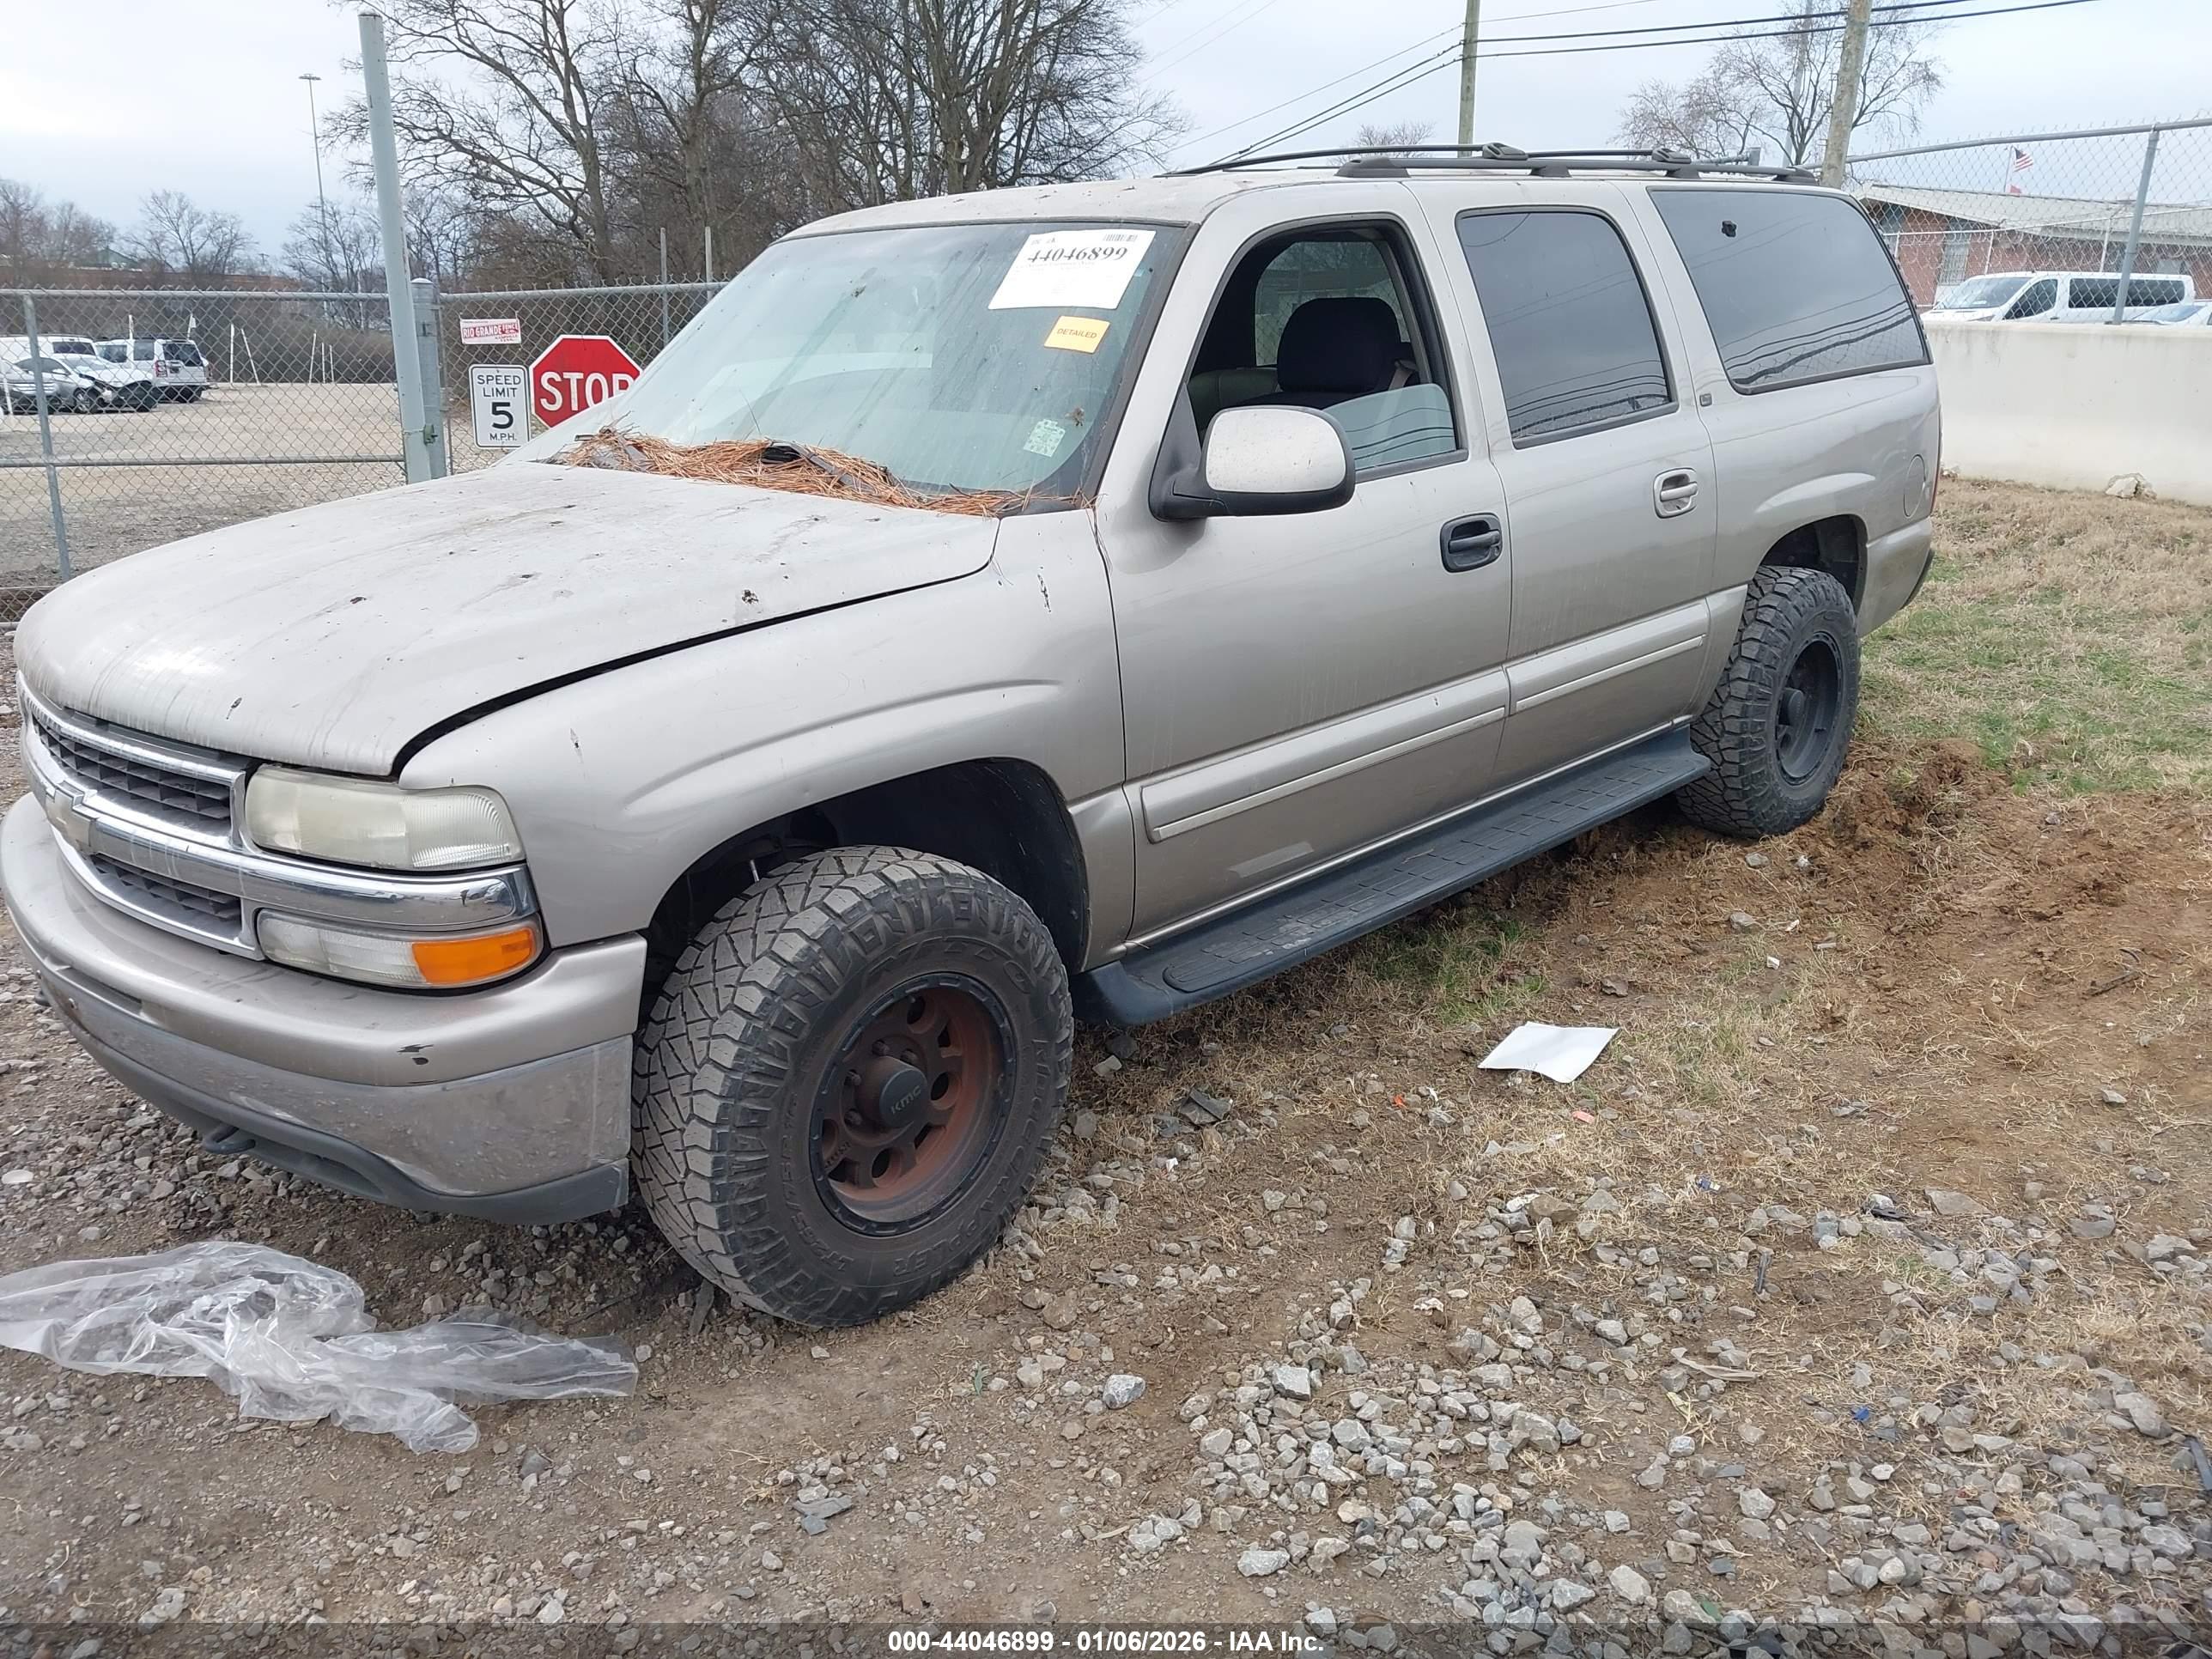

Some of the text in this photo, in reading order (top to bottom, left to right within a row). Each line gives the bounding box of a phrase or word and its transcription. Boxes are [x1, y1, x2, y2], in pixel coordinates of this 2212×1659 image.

[1028, 246, 1127, 263] 44046899
[463, 324, 502, 337] RIO GRANDE
[1056, 328, 1097, 340] DETAILED
[477, 374, 521, 386] SPEED
[483, 387, 518, 398] LIMIT
[491, 402, 514, 429] 5
[489, 433, 518, 442] M.P.H.
